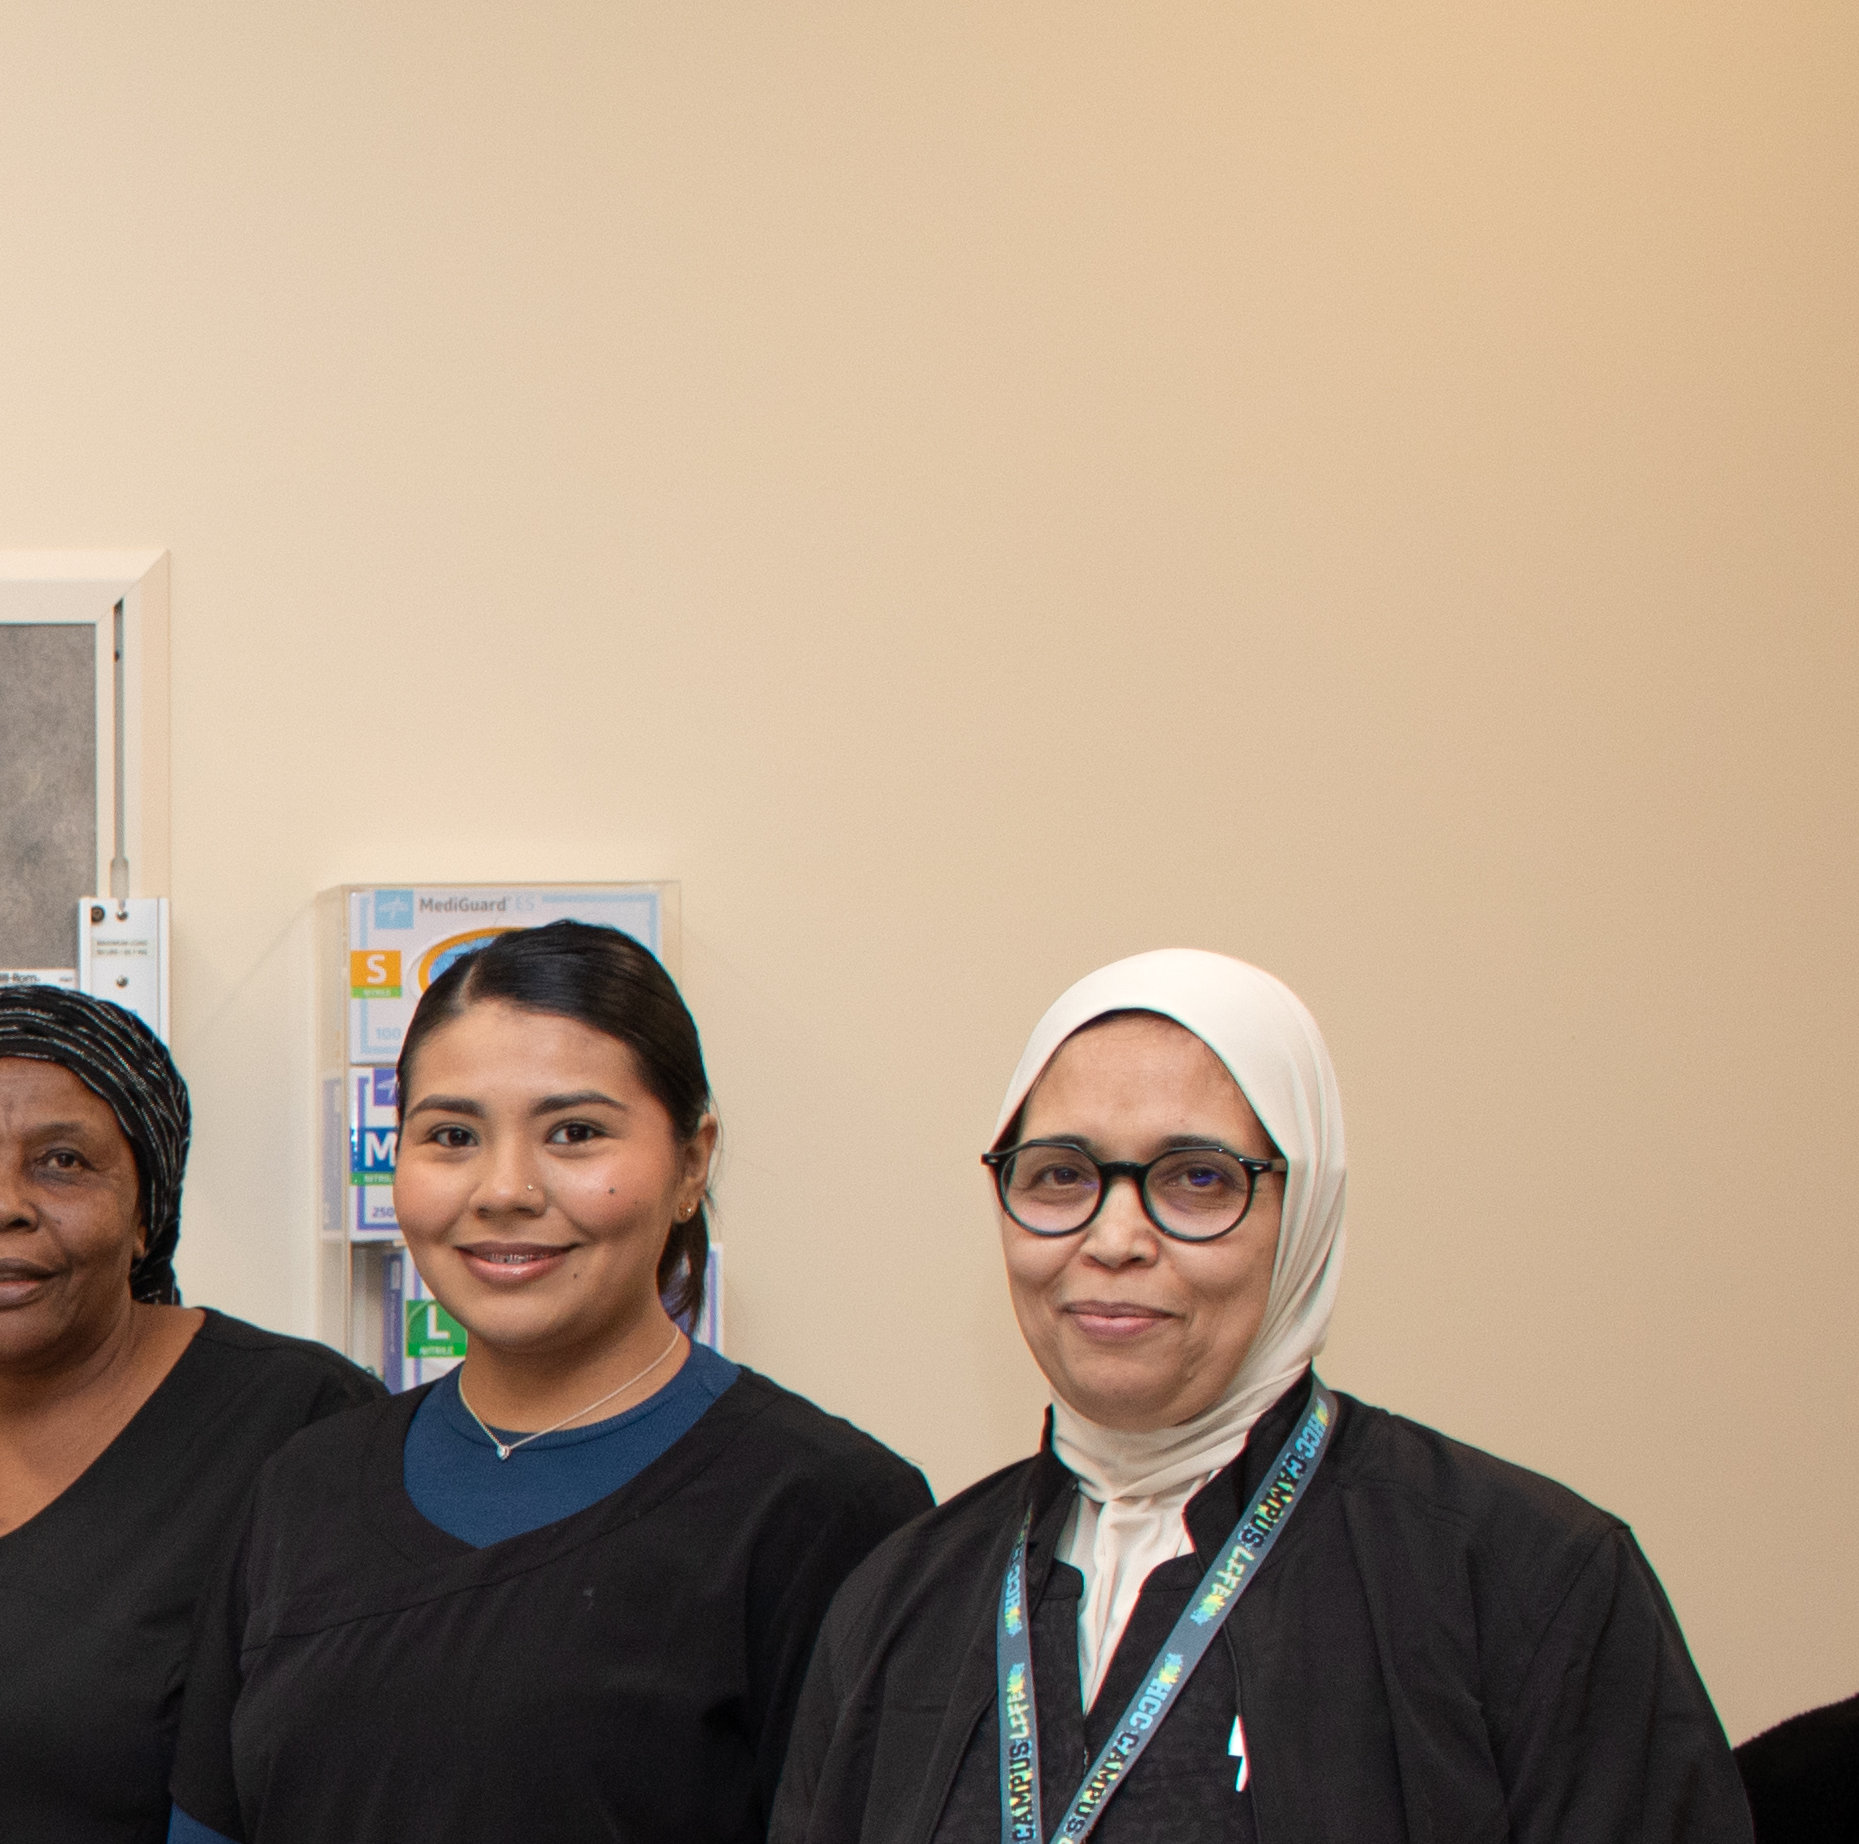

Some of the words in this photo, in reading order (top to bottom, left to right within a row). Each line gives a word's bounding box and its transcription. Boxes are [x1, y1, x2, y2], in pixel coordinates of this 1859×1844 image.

[419, 896, 507, 912] MediGuard
[366, 954, 387, 984] S
[365, 1131, 397, 1168] M
[428, 1305, 450, 1339] L
[1295, 1413, 1326, 1459] HCC
[1240, 1453, 1308, 1548] CAMPUS
[1129, 1677, 1173, 1730] HCC
[1009, 1741, 1034, 1842] CAMPUS
[1065, 1730, 1139, 1835] CAMPUS
